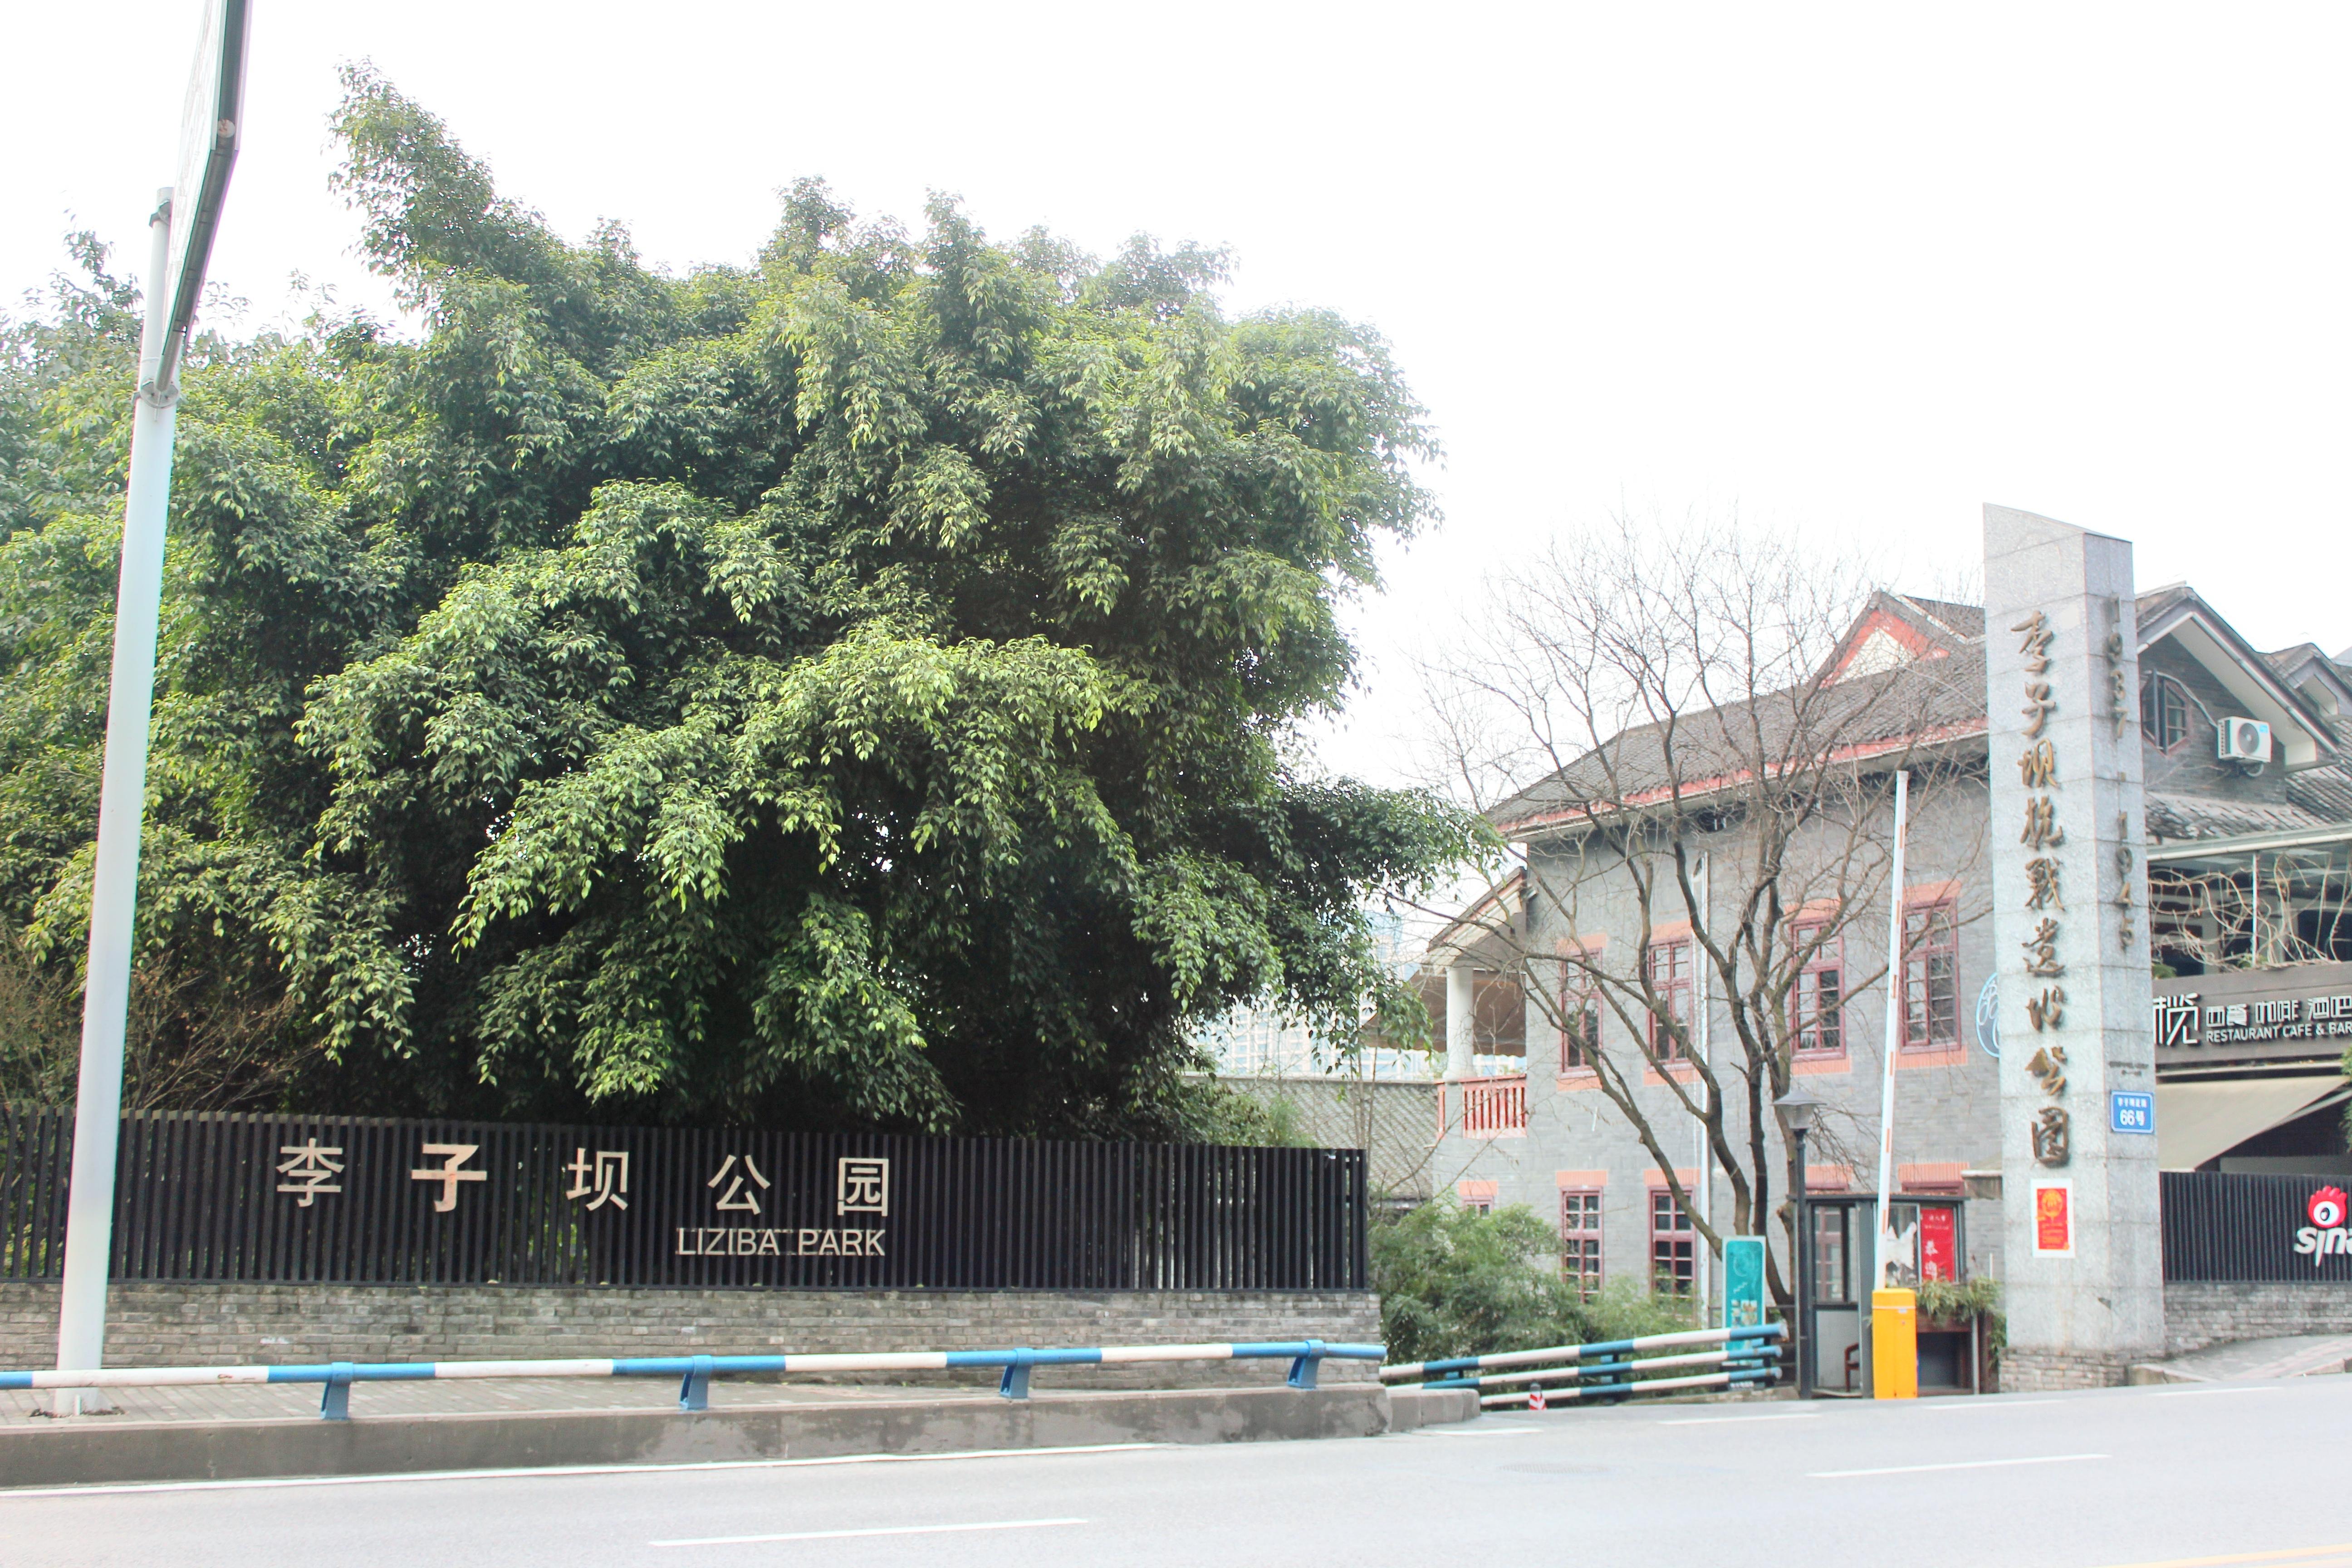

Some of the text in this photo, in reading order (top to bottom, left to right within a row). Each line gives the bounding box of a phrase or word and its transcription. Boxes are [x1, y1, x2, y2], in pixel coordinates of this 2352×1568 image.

[2255, 1000, 2299, 1024] 咖啡
[2308, 995, 2352, 1021] 酒吧
[2206, 1021, 2352, 1043] RESTAURANT CAFE & BAR
[2119, 1109, 2146, 1127] 66号
[276, 1138, 889, 1217] 李子坝公园
[679, 1228, 886, 1256] LIZIBA PARK
[2293, 1226, 2352, 1268] sin
